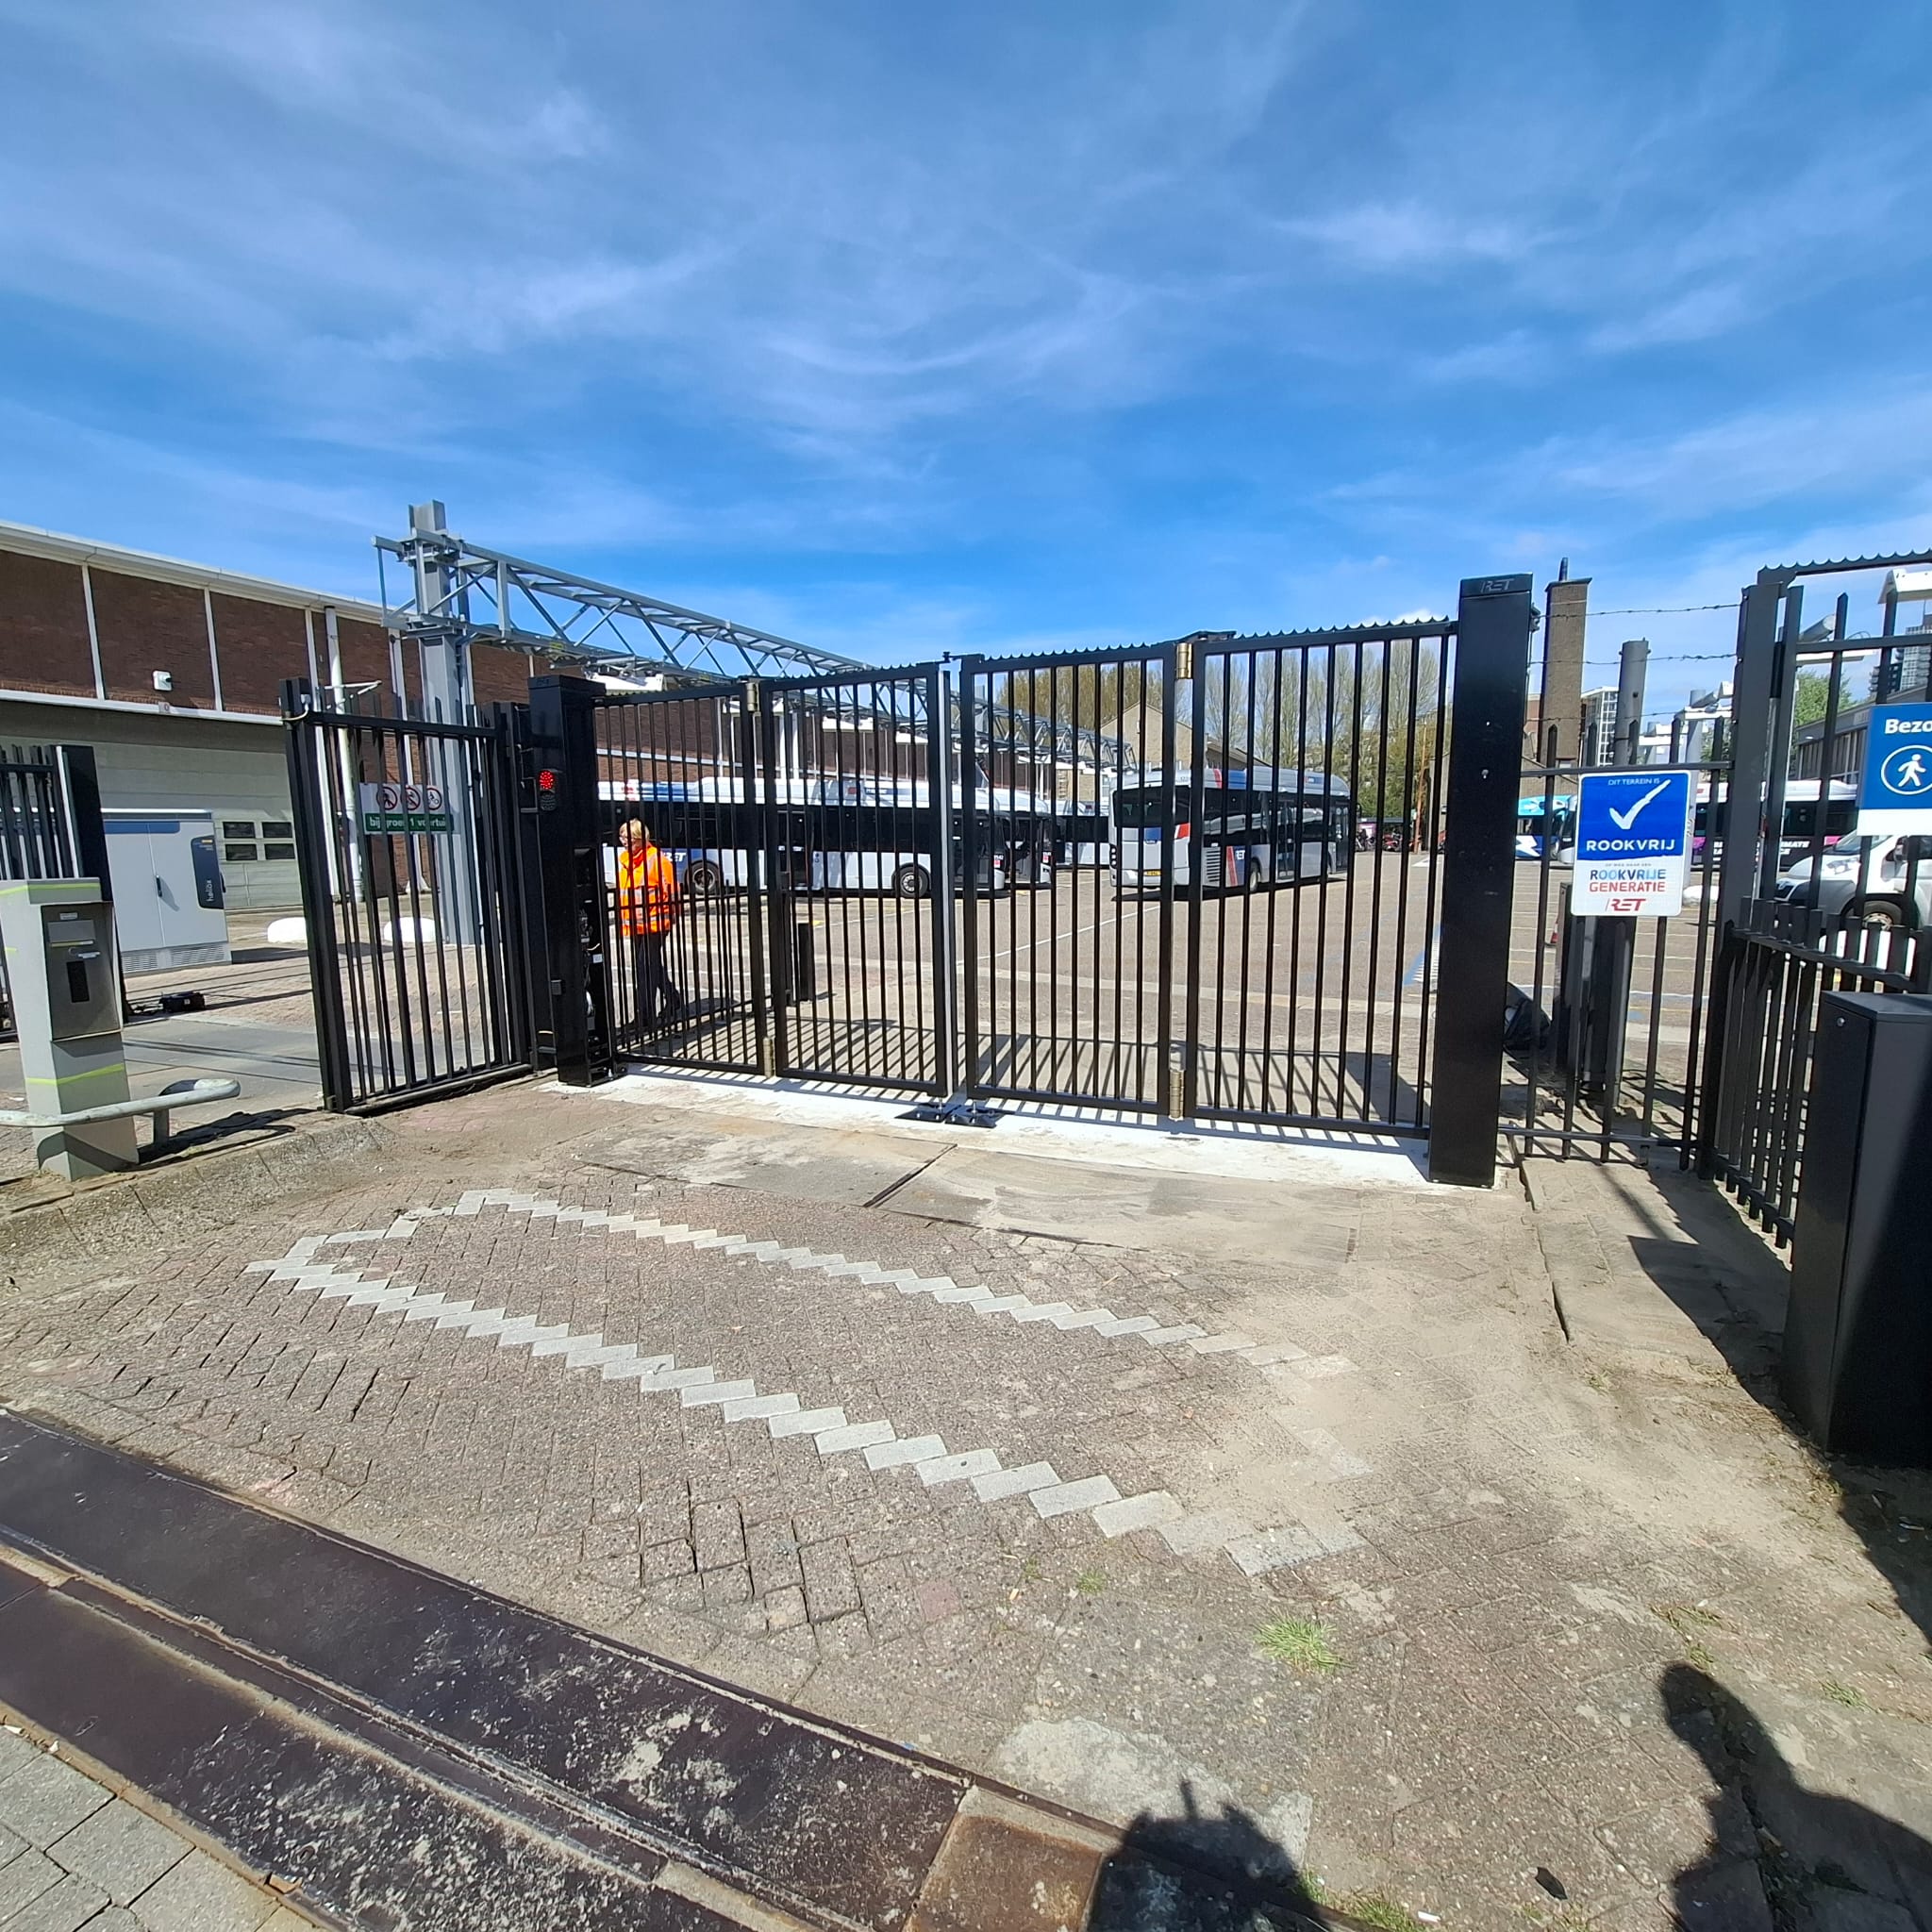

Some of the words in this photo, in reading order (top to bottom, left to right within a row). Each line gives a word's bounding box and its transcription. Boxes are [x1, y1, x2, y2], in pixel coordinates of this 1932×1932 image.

[1482, 578, 1515, 592] RET
[1586, 839, 1675, 852] ROOKVRIJ
[1590, 868, 1667, 880] ROOKVRIJE
[1589, 881, 1666, 892] GENERATIE
[1609, 898, 1646, 912] RET
